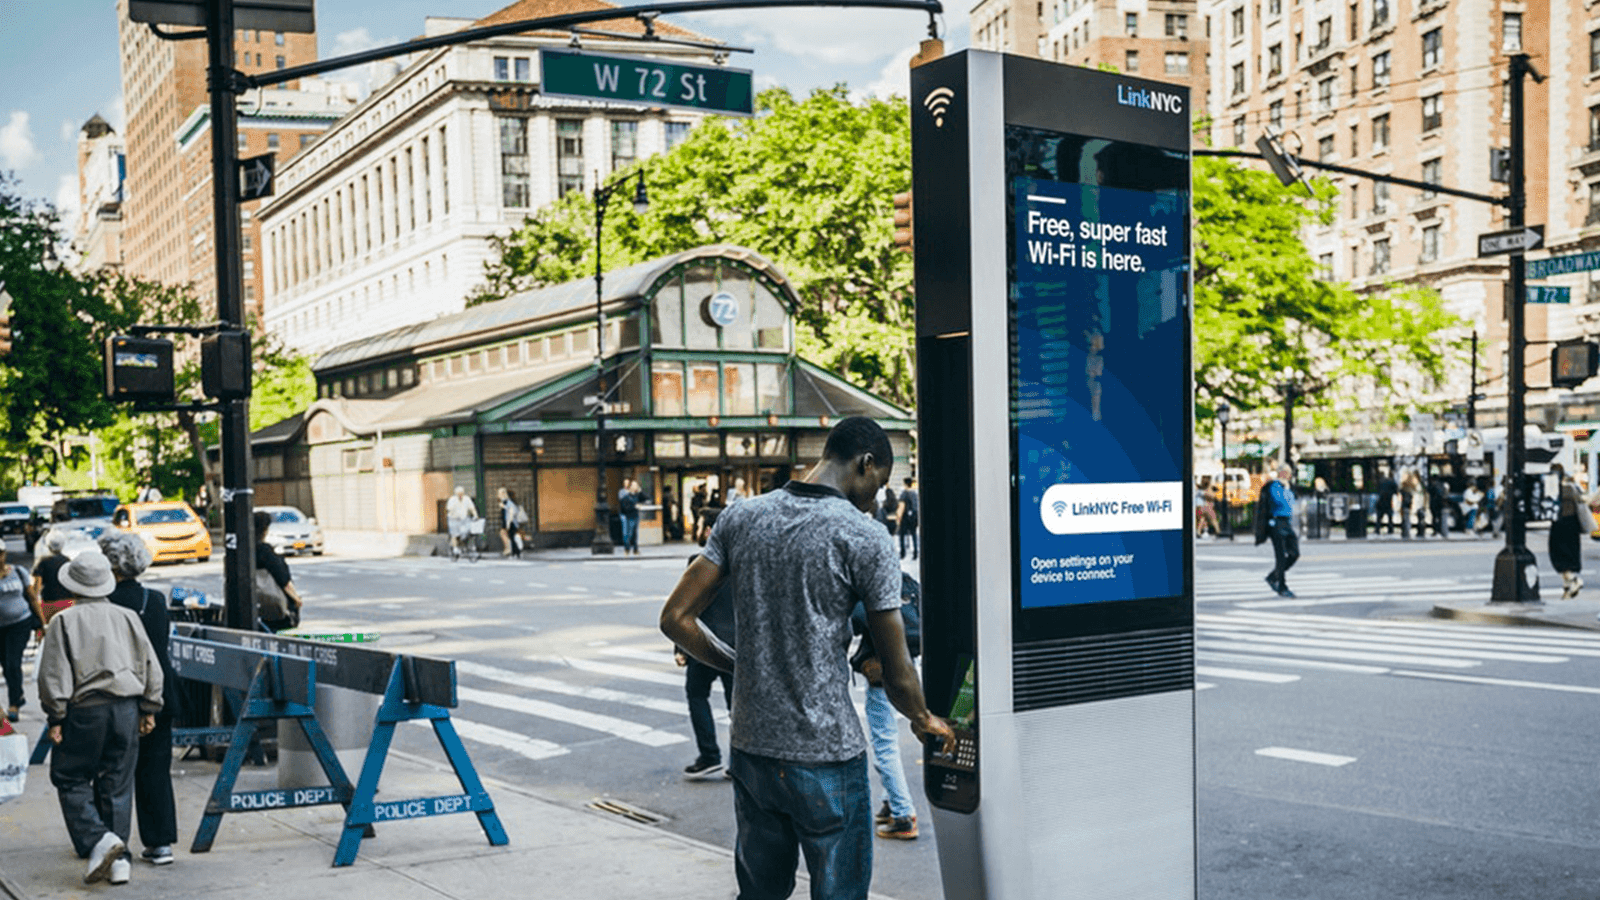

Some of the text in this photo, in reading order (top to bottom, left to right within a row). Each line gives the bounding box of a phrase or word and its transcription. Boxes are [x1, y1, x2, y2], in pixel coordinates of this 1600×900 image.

[593, 62, 707, 102] W 72 St
[1117, 84, 1183, 114] LinkNYC
[1028, 210, 1168, 247] Free, super fast
[1507, 237, 1525, 246] WAY
[1028, 240, 1146, 273] Wi-Fi is here.
[1527, 253, 1600, 278] BROADWAY
[1544, 287, 1559, 304] 72
[713, 299, 736, 319] 72
[1072, 500, 1172, 516] LinkNYC Free Wi-Fi
[1030, 553, 1134, 571] Open settings on your
[1030, 567, 1117, 584] device to connect.
[230, 792, 286, 810] POLICE
[374, 796, 472, 820] POLICE DEPT
